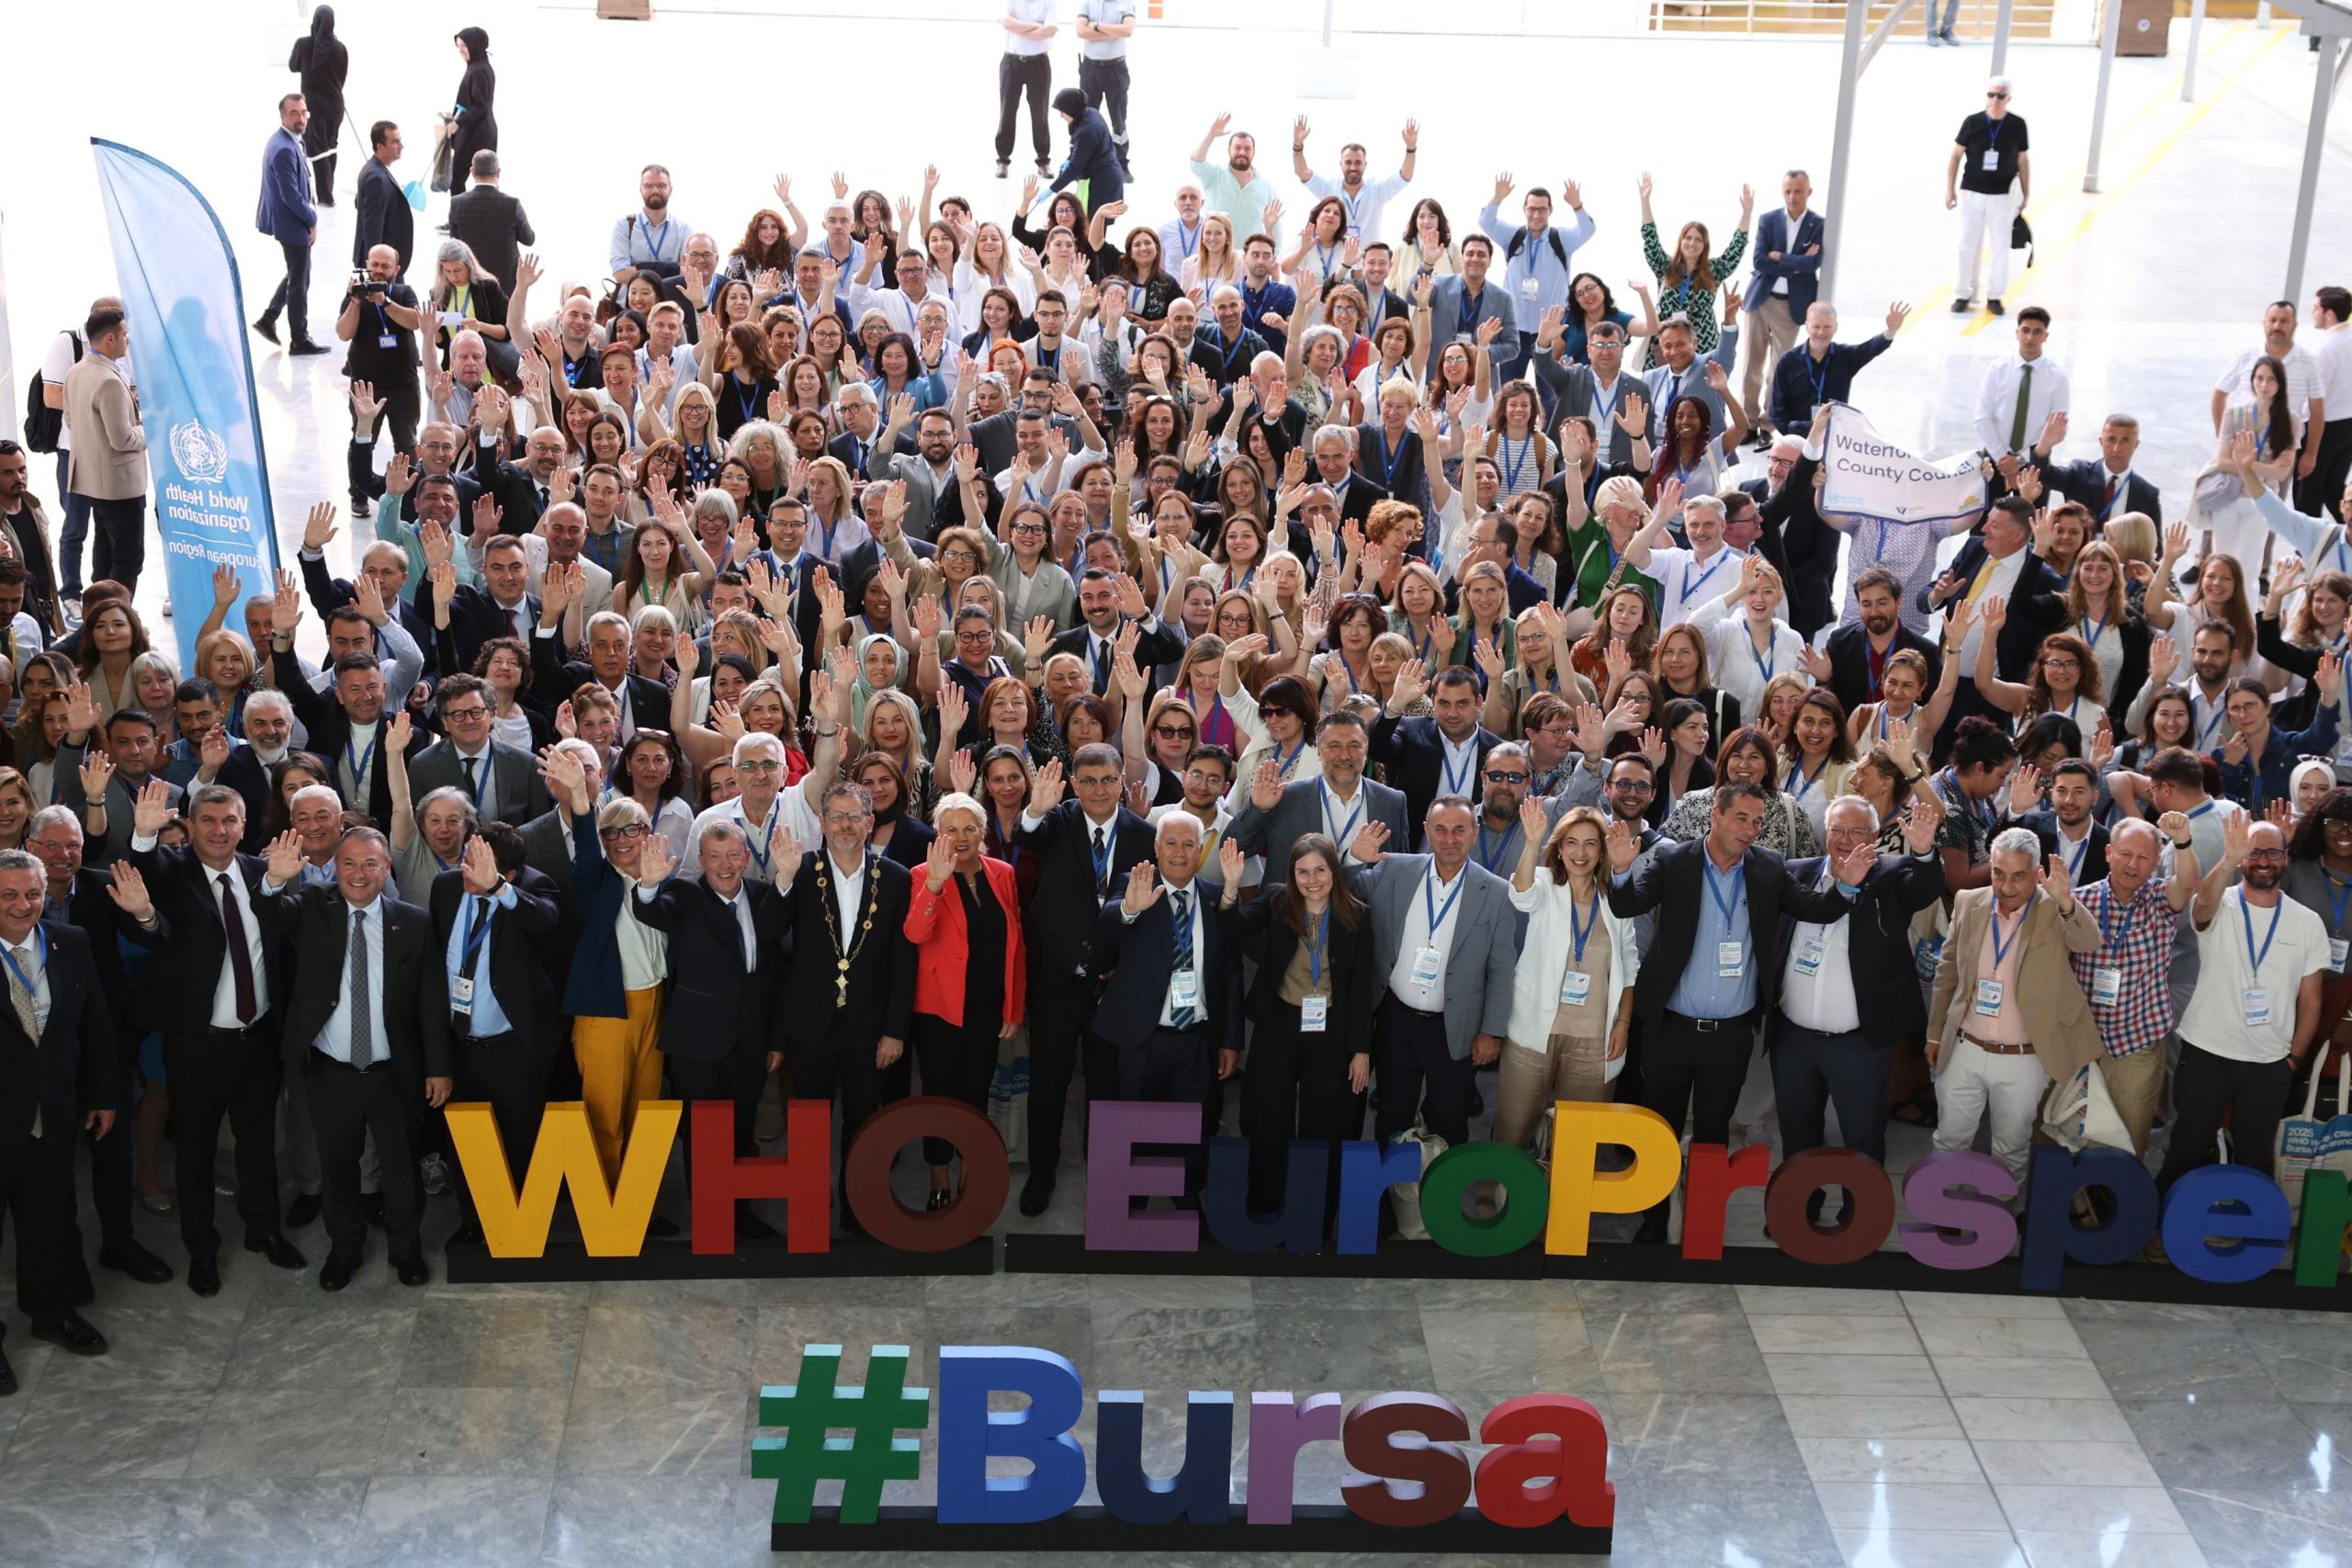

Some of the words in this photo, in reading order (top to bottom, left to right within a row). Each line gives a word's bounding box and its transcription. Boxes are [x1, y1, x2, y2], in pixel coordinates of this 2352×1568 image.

[1838, 457, 1904, 484] County
[2287, 1137, 2309, 1145] WHO
[2288, 1127, 2314, 1138] 2025
[2286, 1144, 2312, 1154] Bursa
[445, 1097, 1010, 1258] WHO
[752, 1344, 1615, 1529] #Bursa
